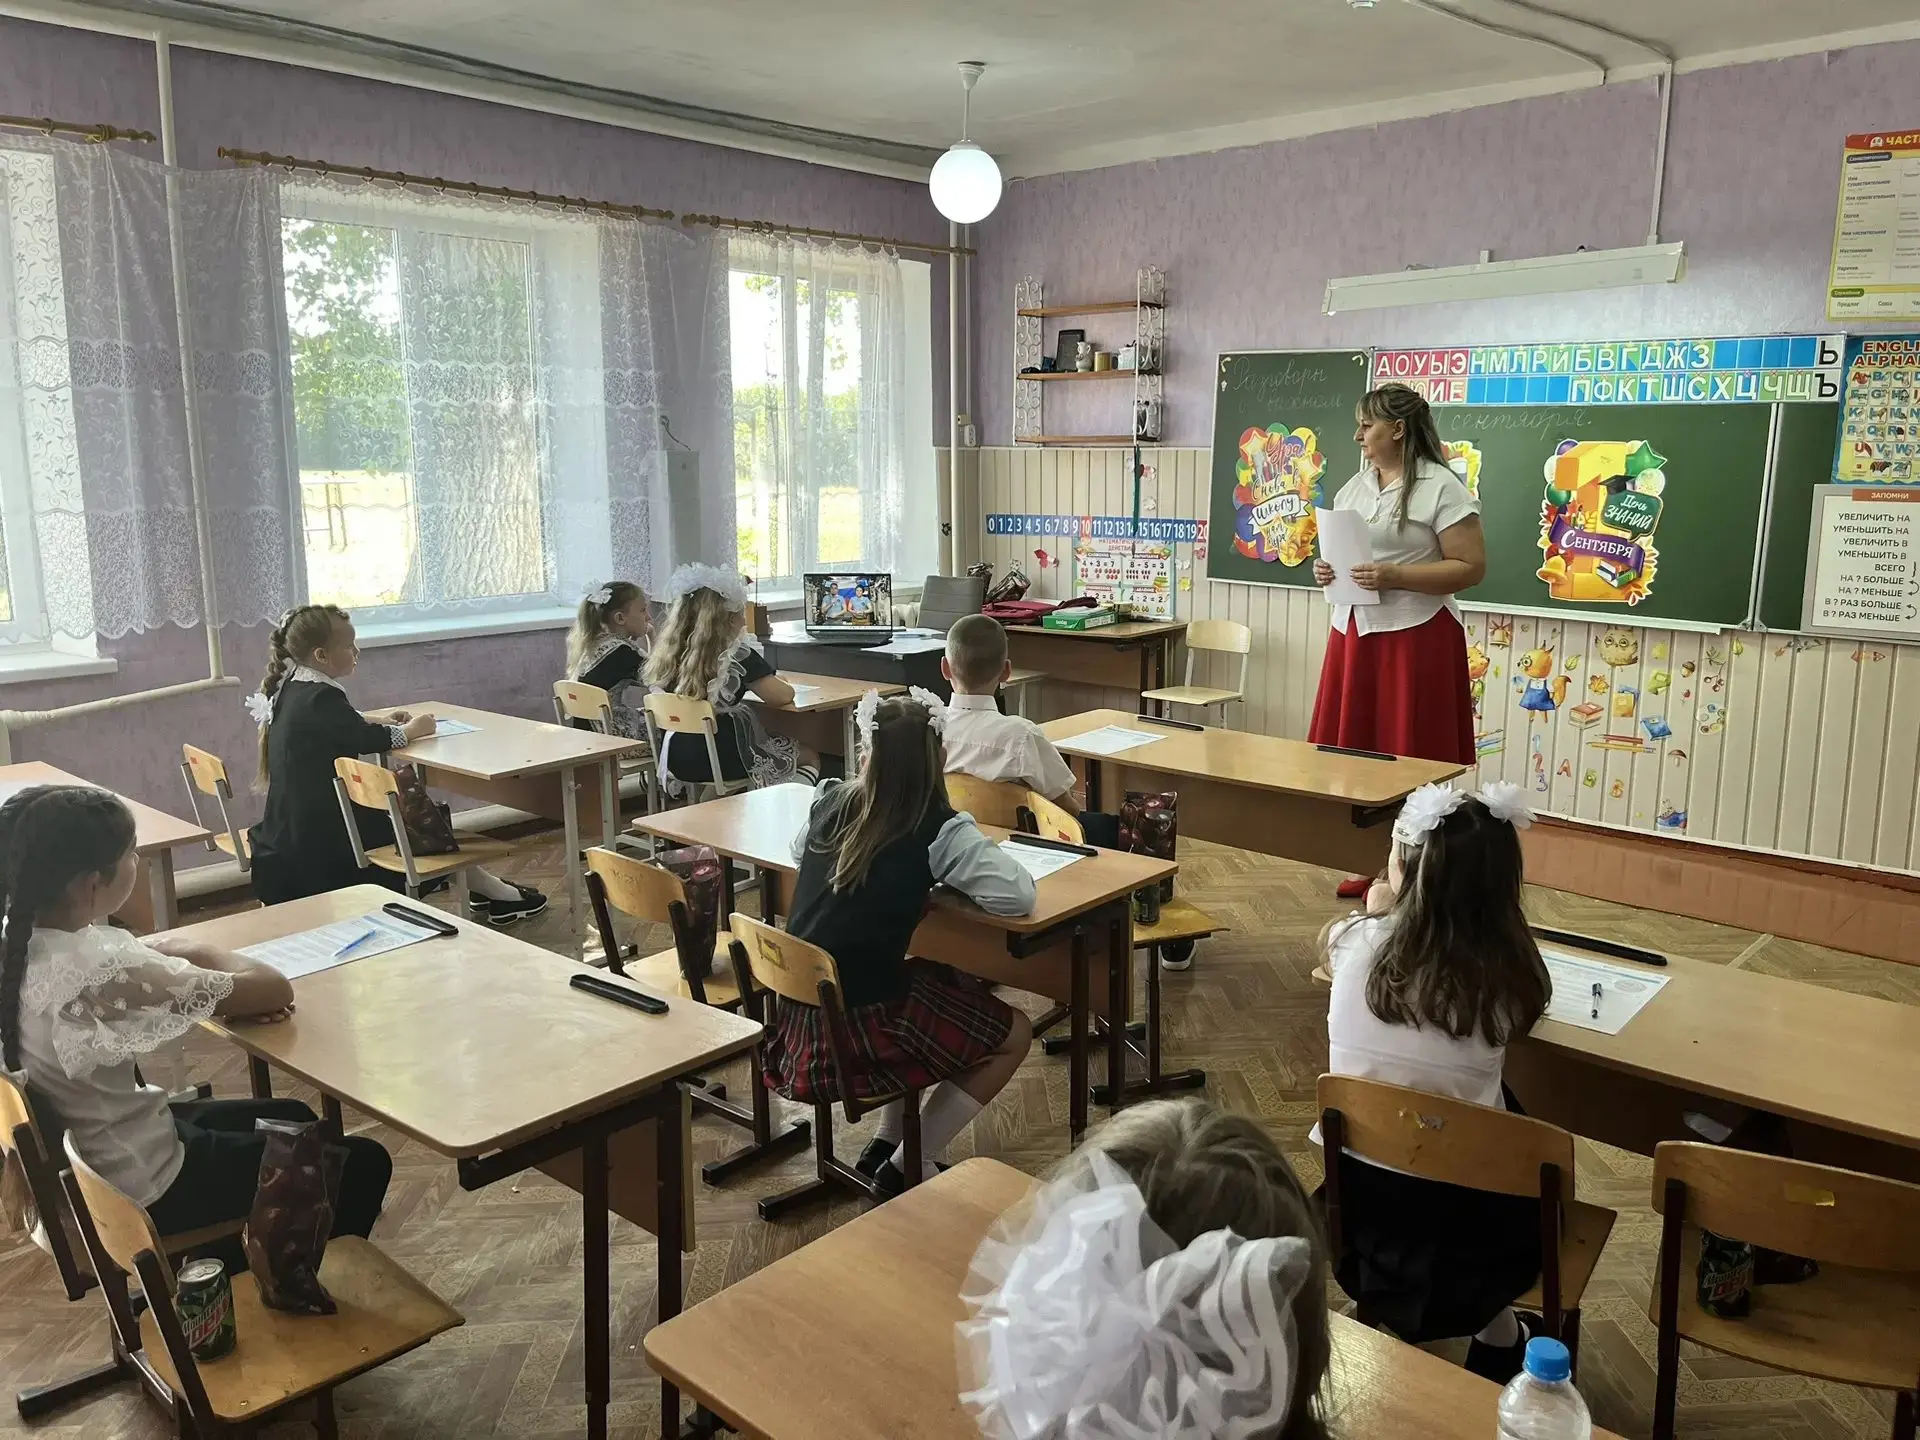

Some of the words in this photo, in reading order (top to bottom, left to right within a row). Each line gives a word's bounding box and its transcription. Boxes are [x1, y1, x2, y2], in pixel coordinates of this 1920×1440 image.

[1886, 135, 1920, 145] ЧАСТ
[1376, 355, 1391, 376] А
[1395, 354, 1410, 375] О
[1412, 353, 1428, 375] У
[1430, 353, 1448, 374] Ы
[1450, 352, 1467, 374] Э
[1470, 352, 1485, 374] Н
[1489, 351, 1508, 373] М
[1574, 349, 1592, 372] Б
[1597, 348, 1614, 371] В
[1665, 345, 1688, 369] Ж
[1854, 355, 1920, 366] ALPHA
[1430, 381, 1445, 402] И
[1449, 381, 1465, 402] Е
[1571, 379, 1589, 402] П
[1593, 380, 1612, 400] Ф
[1617, 378, 1636, 401] К
[1641, 378, 1659, 400] Т
[1871, 492, 1910, 500] ЗАПОМНИ
[1620, 494, 1648, 511] День
[1604, 503, 1654, 530] ЗНАНИЙ
[1838, 512, 1895, 523] УВЕЛИЧИТЬ
[1896, 514, 1910, 522] НА
[988, 518, 995, 531] 0
[998, 518, 1003, 532] 1
[1007, 518, 1013, 532] 2
[1016, 518, 1022, 532] 3
[1025, 518, 1031, 532] 4
[1035, 518, 1041, 533] 5
[1044, 518, 1050, 533] 6
[1054, 519, 1059, 533] 7
[1063, 519, 1069, 533] 8
[1072, 519, 1079, 533] 9
[1081, 519, 1090, 535] 10
[1093, 520, 1101, 535] 11
[1104, 520, 1113, 535] 12
[1115, 521, 1125, 536] 13
[1138, 521, 1148, 537] 15
[1149, 522, 1160, 538] 16
[1162, 522, 1172, 538] 17
[1173, 523, 1185, 538] 18
[1185, 523, 1197, 539] 19
[1832, 525, 1893, 535] УМЕНЬШИТЬ
[1895, 527, 1910, 535] НА
[1843, 538, 1900, 547] УВЕЛИЧИТЬ
[1901, 539, 1908, 547] В
[1837, 550, 1898, 560] УМЕНЬШИТЬ
[1900, 552, 1907, 560] В
[1874, 563, 1906, 573] ВСЕГО
[1840, 574, 1854, 582] НА
[1863, 576, 1905, 585] БОЛЬШЕ
[1838, 586, 1852, 594] НА
[1854, 587, 1859, 595] ?
[1861, 587, 1903, 598] МЕНЬШЕ
[1840, 599, 1859, 607] РАЗ
[1860, 600, 1902, 610] БОЛЬШЕ
[1831, 610, 1837, 618] ?
[1838, 610, 1857, 619] РАЗ
[1858, 612, 1901, 622] МЕНЬШЕ
